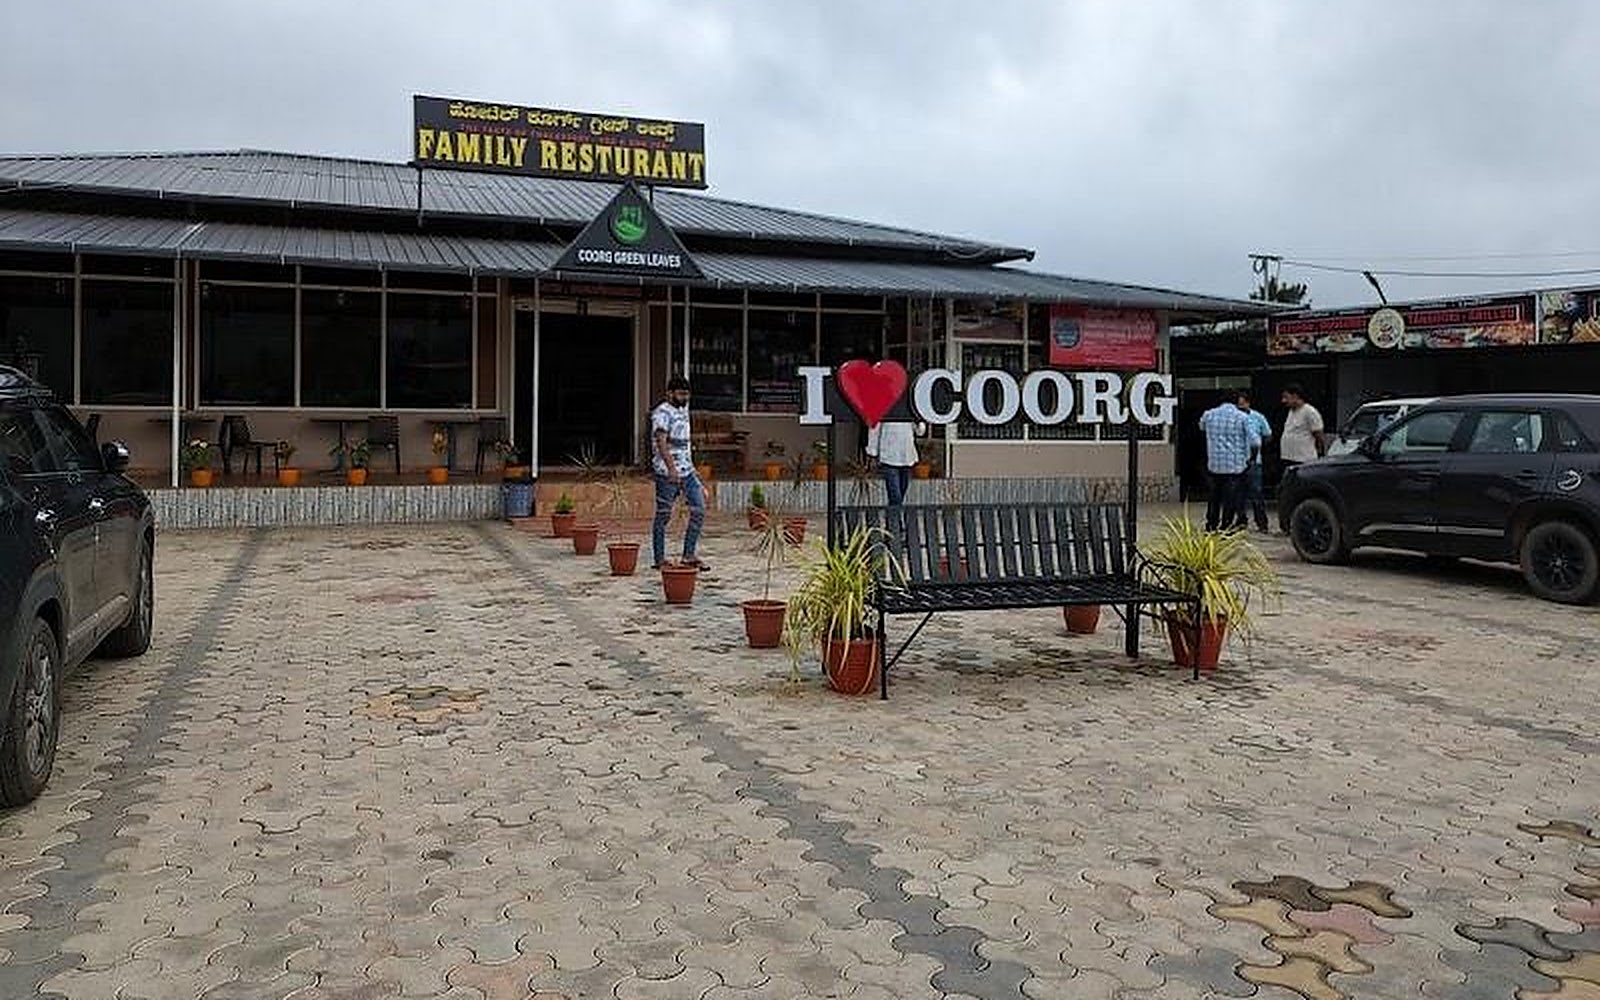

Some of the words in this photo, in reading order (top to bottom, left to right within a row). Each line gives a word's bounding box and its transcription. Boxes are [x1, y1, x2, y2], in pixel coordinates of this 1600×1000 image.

[418, 129, 527, 167] FAMILY
[540, 141, 704, 181] RESTURANT
[578, 249, 613, 264] COORG
[613, 251, 645, 265] GREEN
[647, 253, 681, 268] LEAVES
[798, 366, 833, 425] I
[913, 368, 1178, 426] COORG
